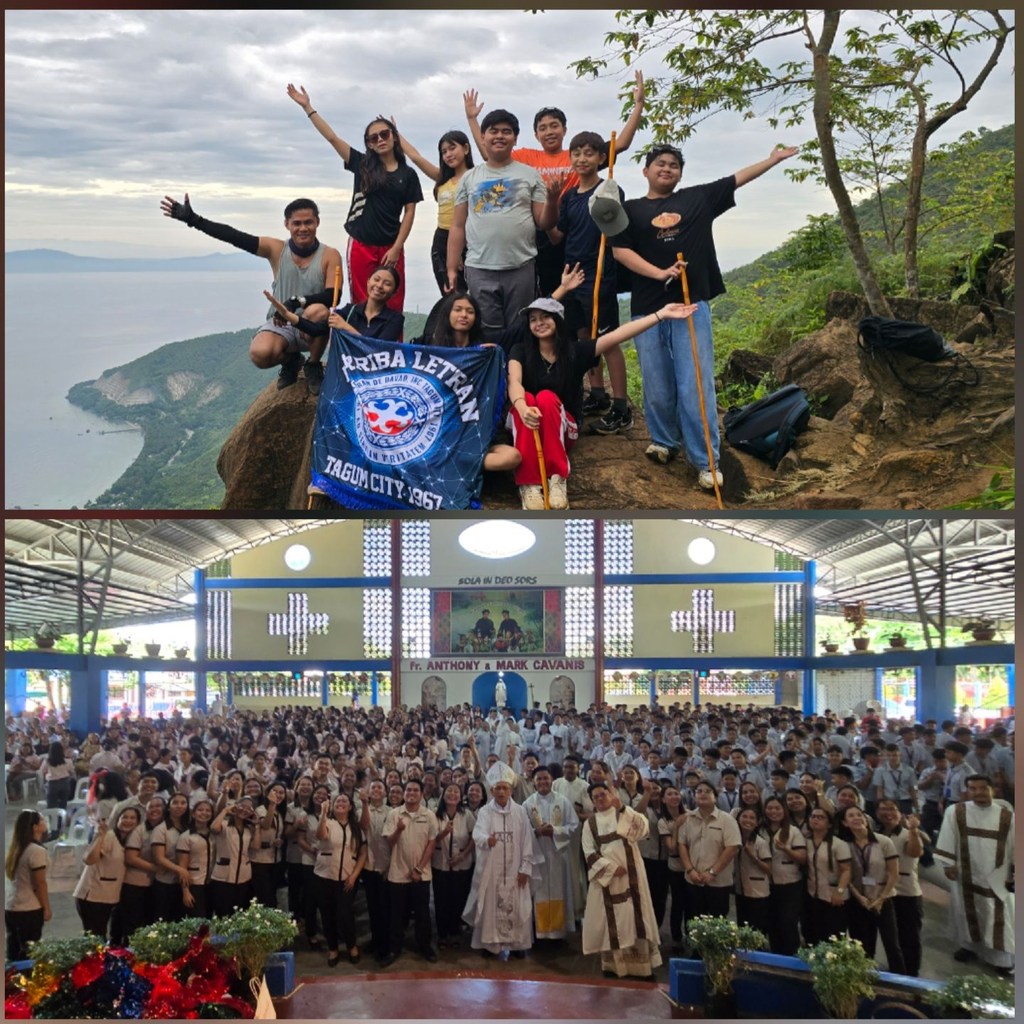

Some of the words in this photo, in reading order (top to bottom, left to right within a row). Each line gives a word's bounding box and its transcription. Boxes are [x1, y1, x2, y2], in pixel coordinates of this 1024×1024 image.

[412, 351, 480, 423] LETRAN
[324, 455, 369, 489] TAGUM
[370, 473, 405, 499] CITY
[407, 486, 443, 510] 1967
[458, 577, 482, 586] SOLA
[483, 577, 493, 585] IN
[495, 576, 513, 584] DEO
[514, 576, 538, 585] SORS
[409, 661, 422, 671] Fr.
[427, 661, 481, 671] ANTHONY
[496, 660, 528, 670] MARK
[533, 660, 585, 670] CAVANIS
